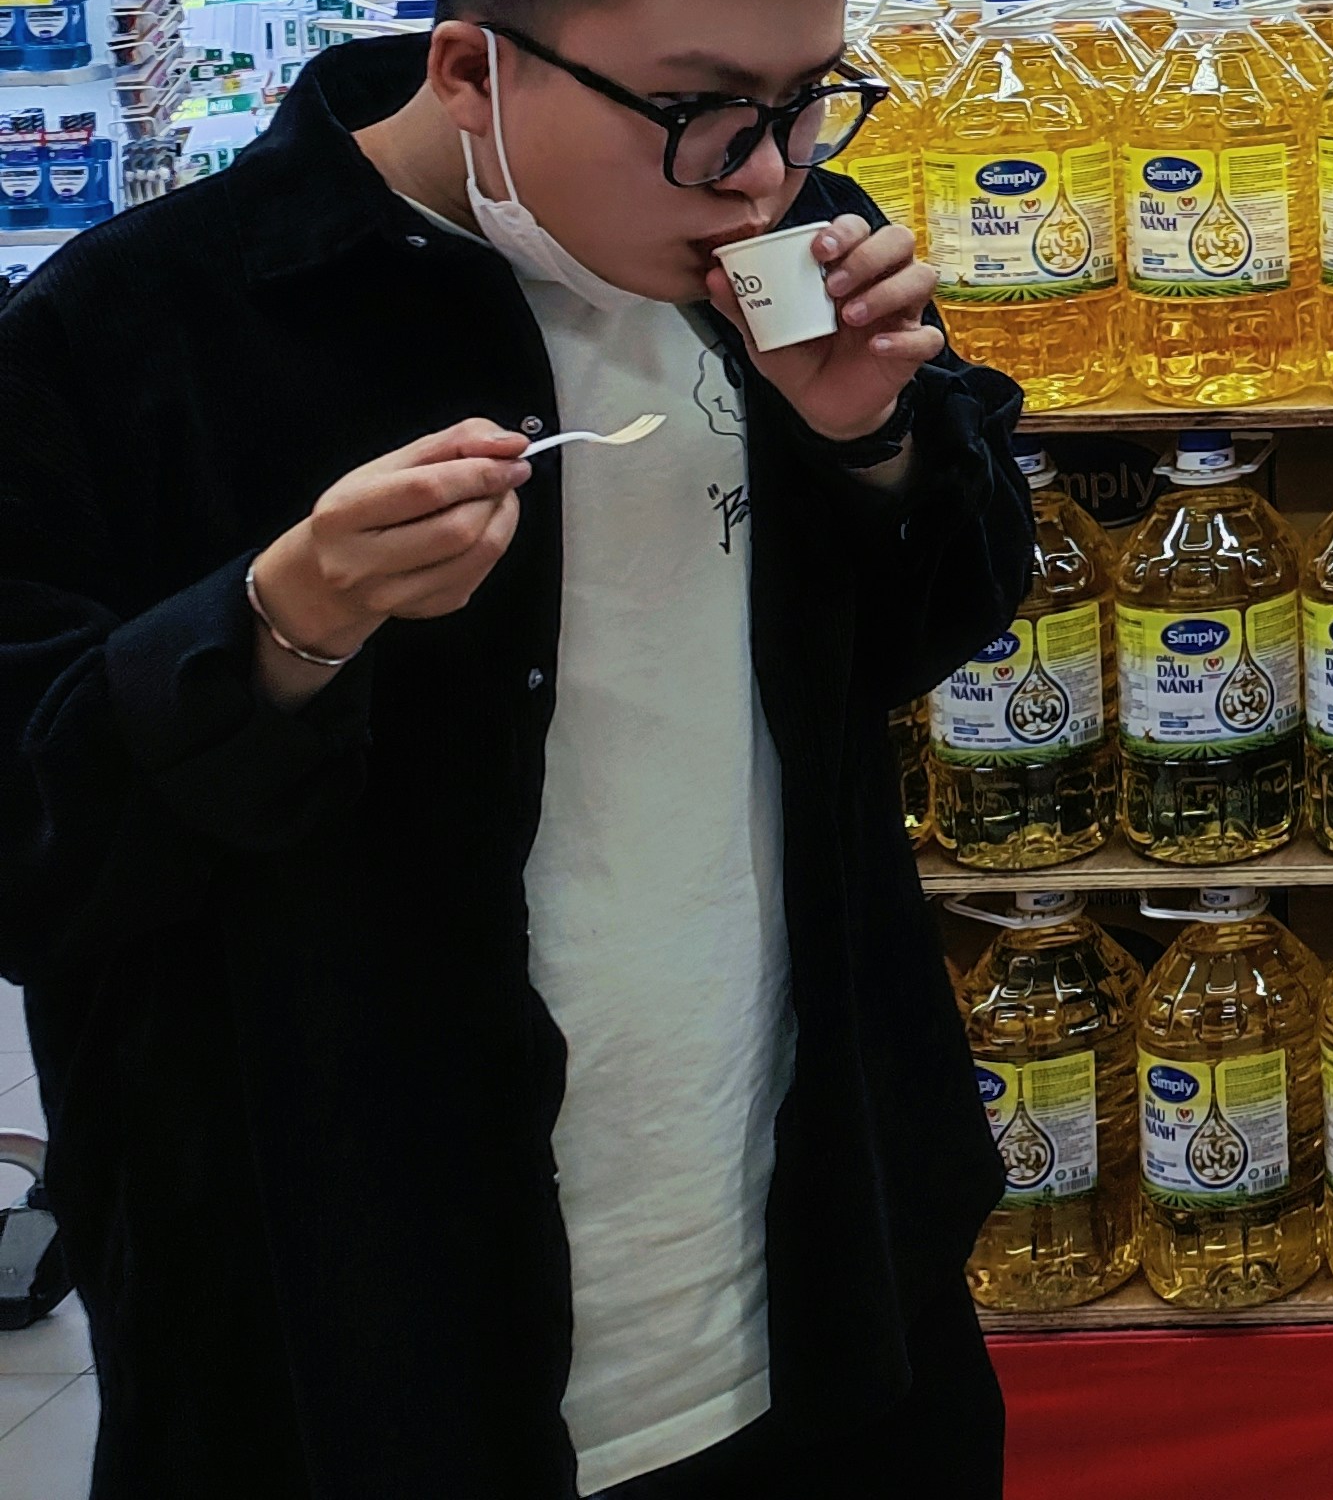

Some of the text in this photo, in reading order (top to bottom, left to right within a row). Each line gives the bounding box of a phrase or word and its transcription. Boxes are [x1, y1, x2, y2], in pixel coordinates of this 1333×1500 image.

[982, 168, 1043, 188] Simply
[1146, 164, 1199, 185] Simply
[1068, 462, 1156, 508] mply
[984, 637, 1014, 655] ply
[1167, 628, 1224, 647] Simply
[979, 1078, 1002, 1097] ply
[1150, 1071, 1194, 1097] Simply
